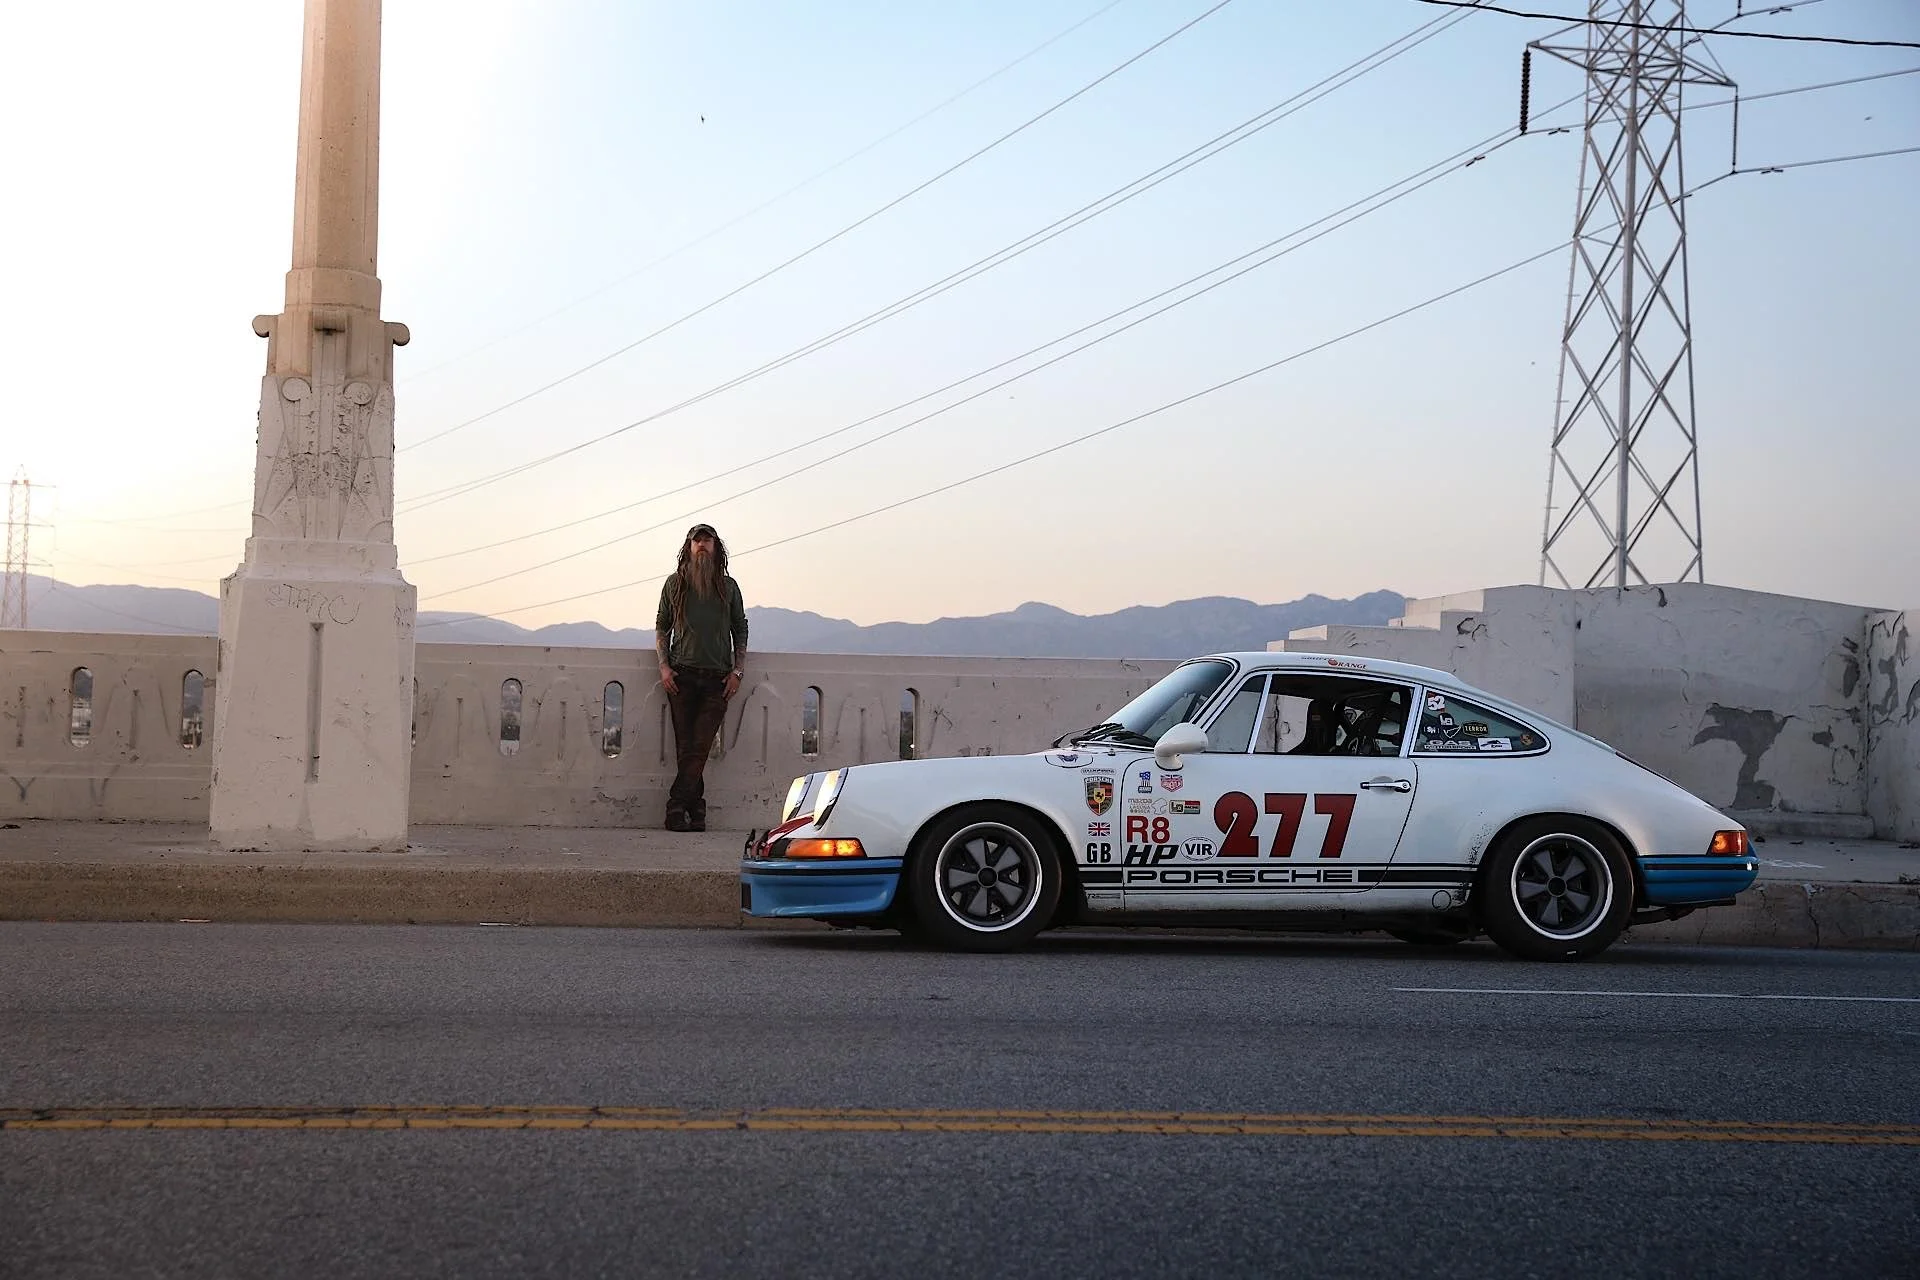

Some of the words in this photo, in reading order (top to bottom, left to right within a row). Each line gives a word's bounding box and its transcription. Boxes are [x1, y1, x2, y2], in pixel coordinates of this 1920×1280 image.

[1427, 695, 1445, 711] 52
[1126, 815, 1170, 844] R8
[1213, 790, 1358, 858] 277
[1086, 842, 1112, 863] GB
[1124, 845, 1180, 865] HP
[1184, 843, 1213, 856] VIR
[1126, 870, 1353, 884] PORSCHE
